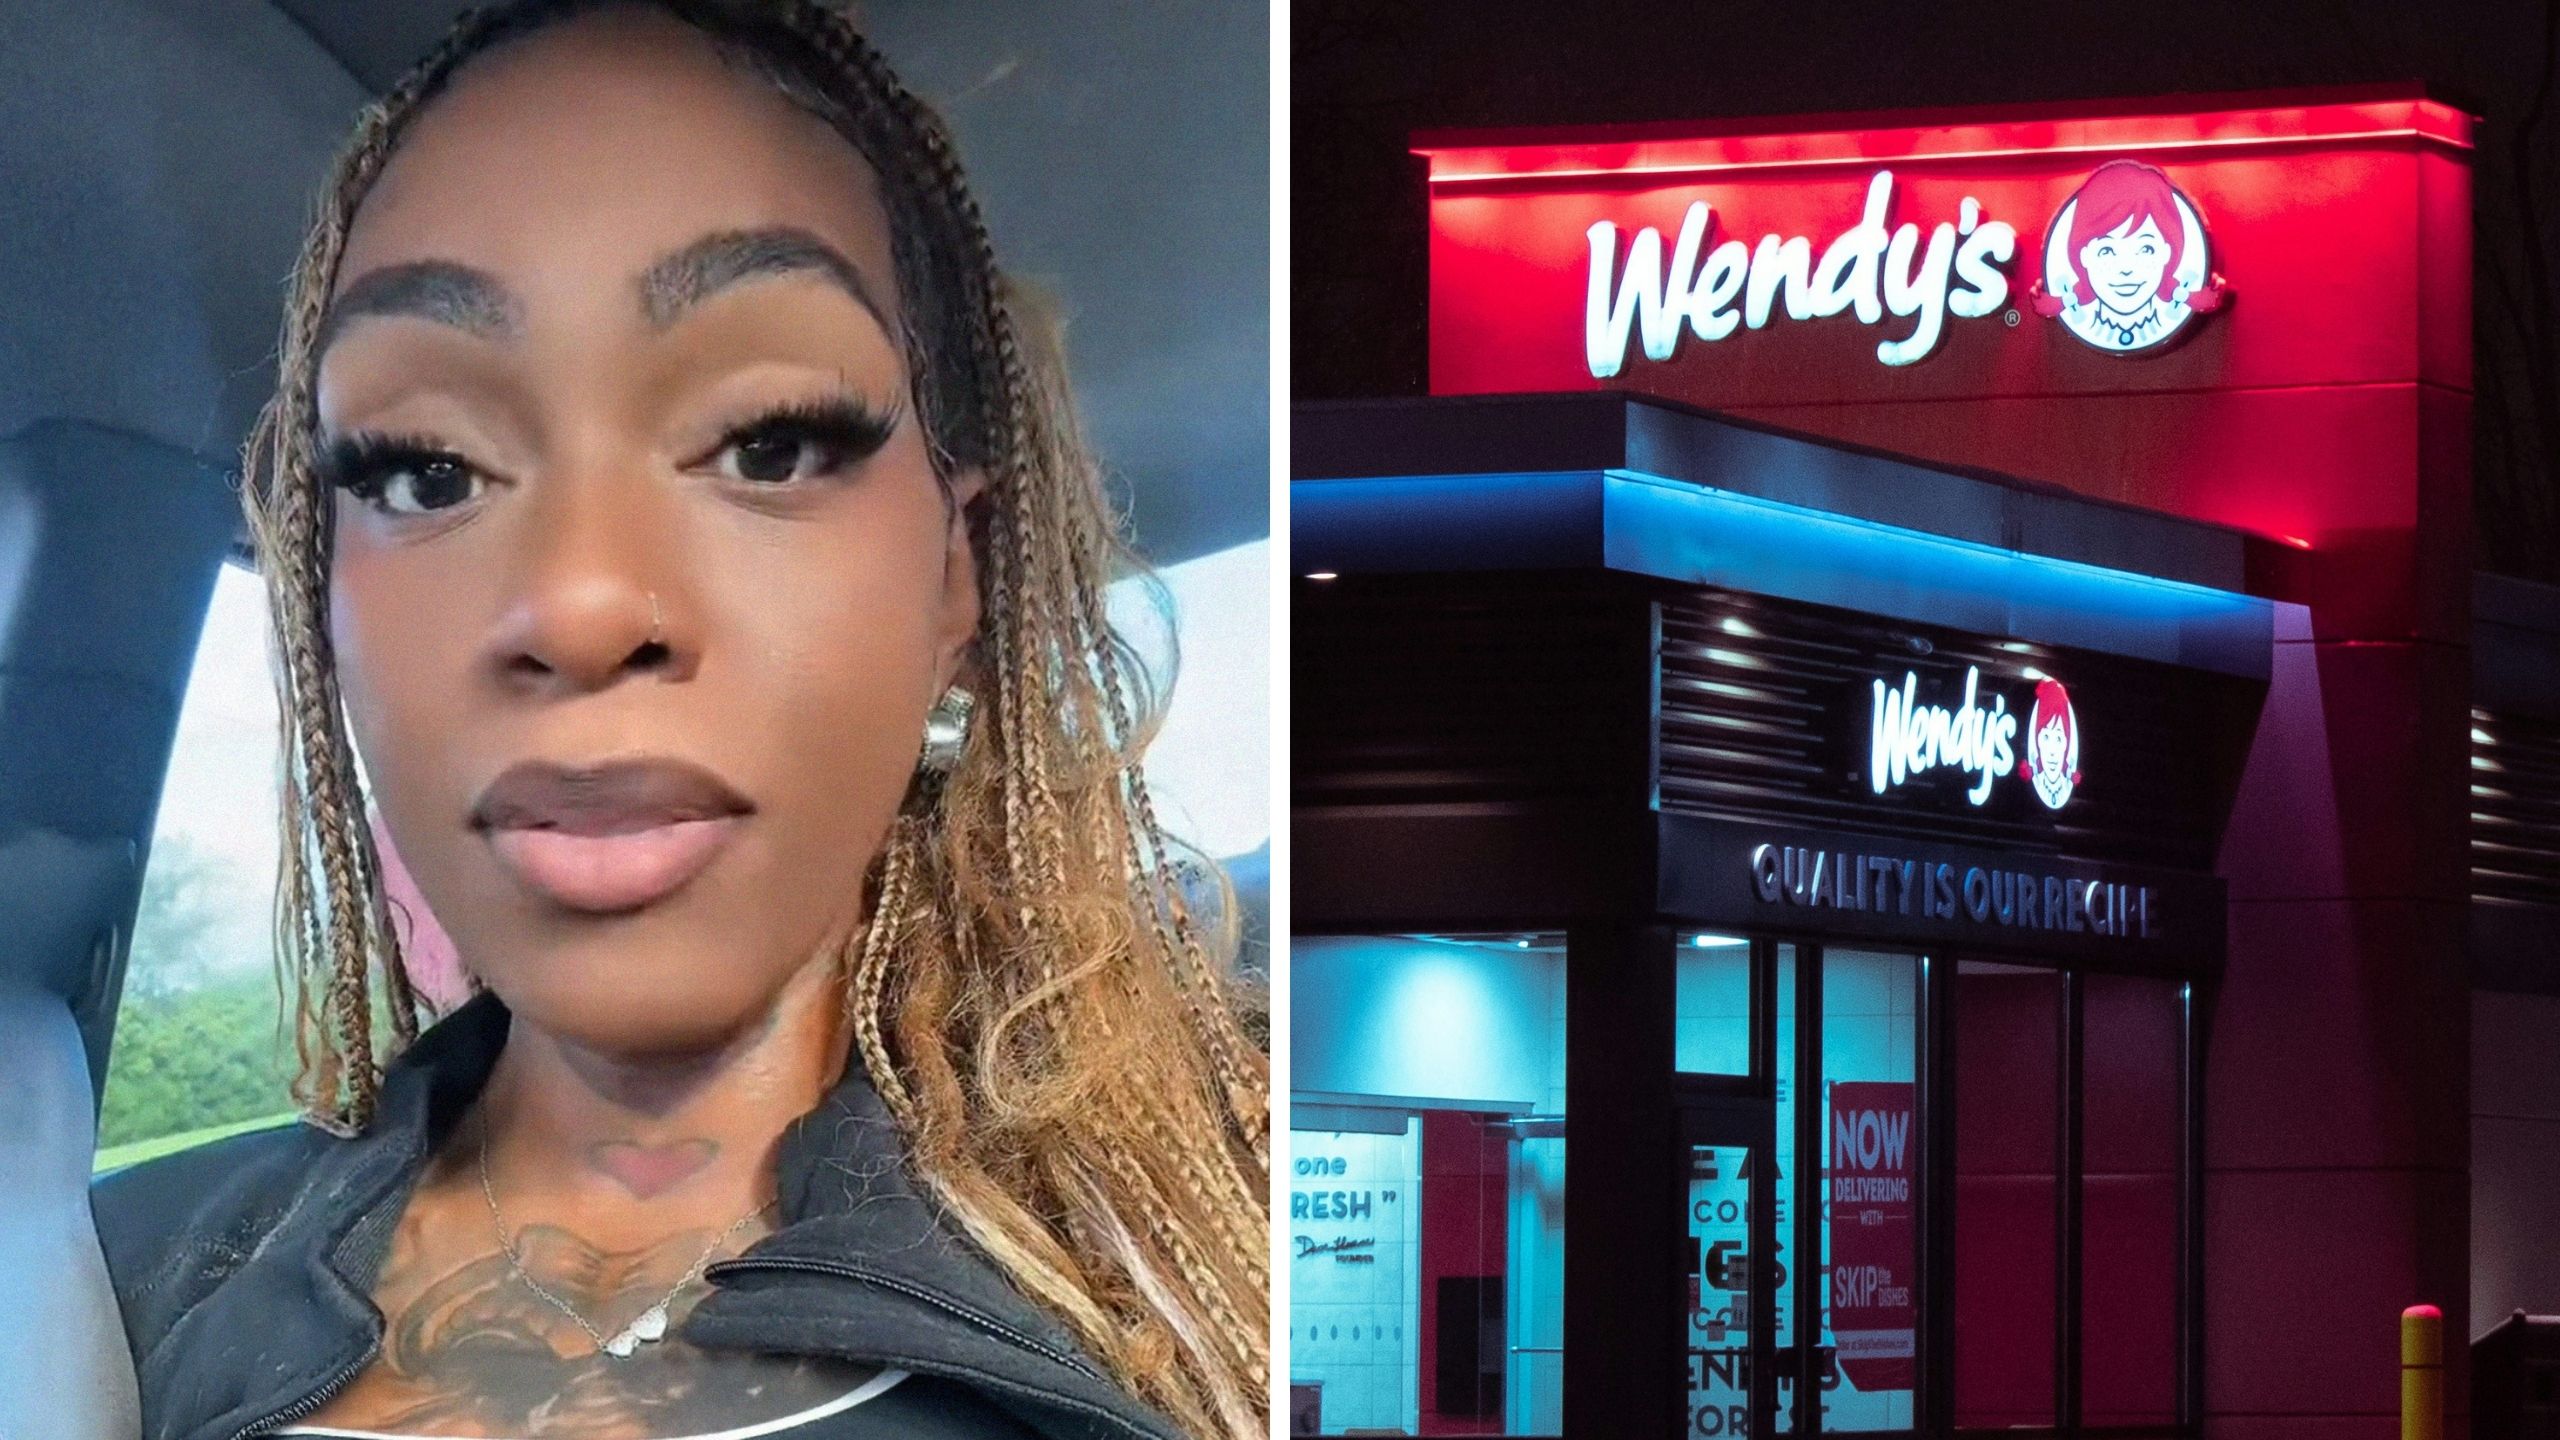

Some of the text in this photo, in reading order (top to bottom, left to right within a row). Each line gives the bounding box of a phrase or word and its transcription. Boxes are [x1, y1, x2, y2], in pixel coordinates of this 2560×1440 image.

[1586, 170, 2015, 378] Wendy's
[1870, 665, 2016, 805] Wendy's
[1753, 843, 1916, 914] QUALITY
[1924, 862, 1955, 919] IS
[1964, 867, 2038, 928] OUR
[1836, 1109, 1909, 1170] NOW
[1294, 1156, 1347, 1175] one
[1835, 1177, 1908, 1202] DELIVERING
[1860, 1209, 1883, 1226] WITH
[1835, 1265, 1877, 1308] SKIP
[1878, 1287, 1909, 1307] DISHES
